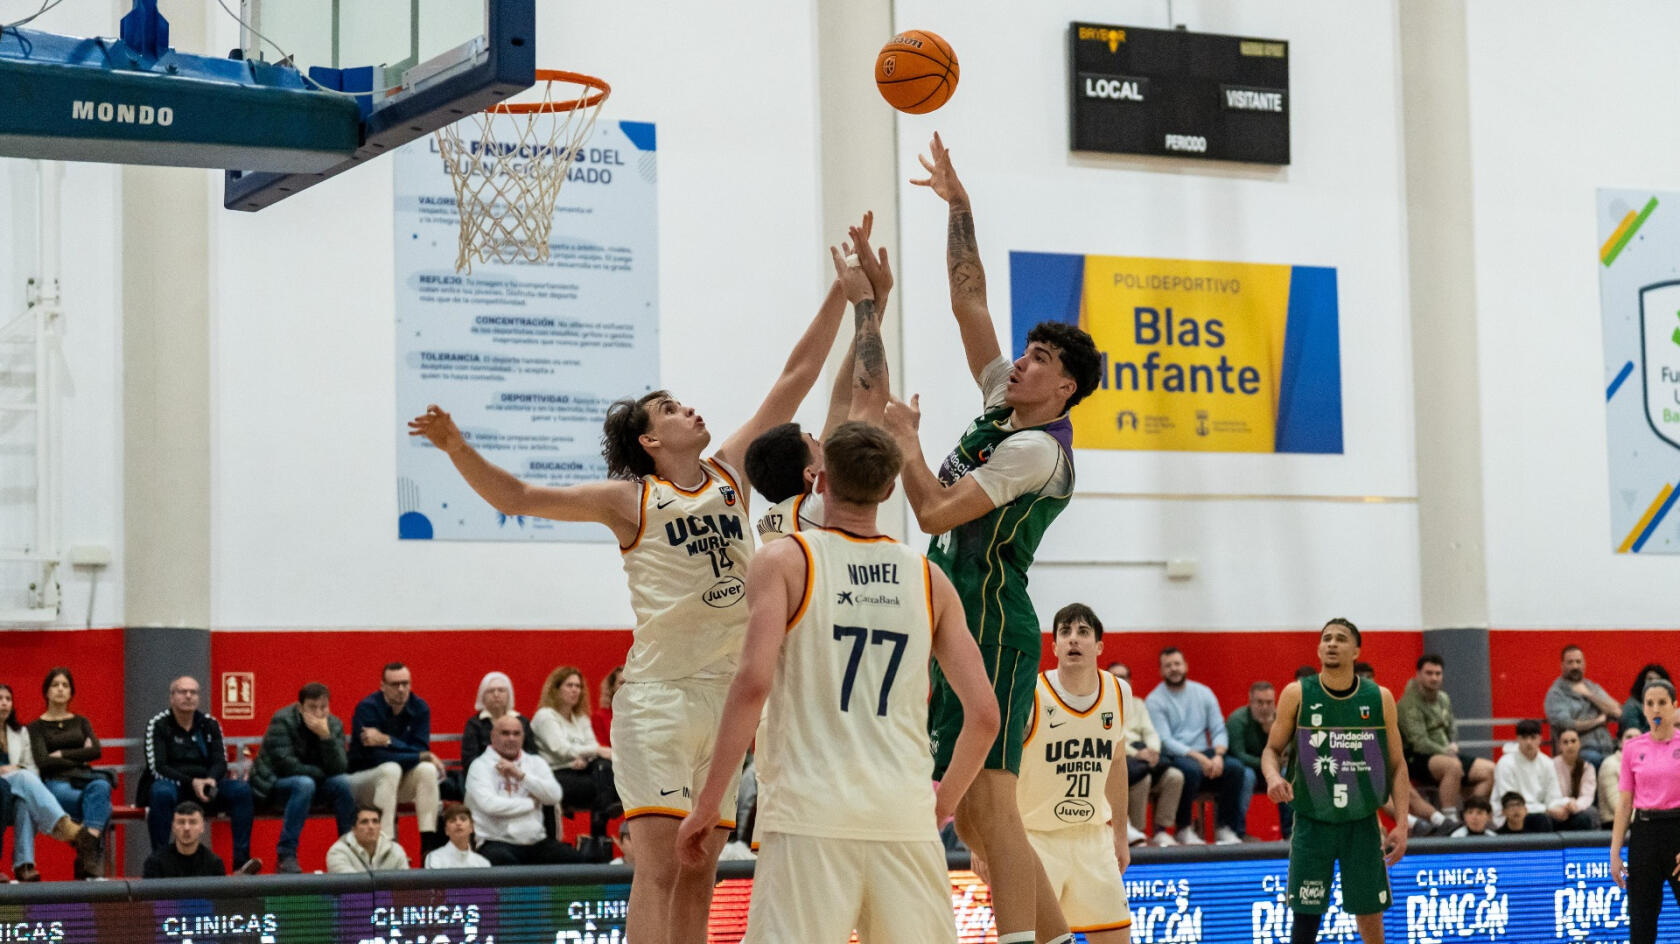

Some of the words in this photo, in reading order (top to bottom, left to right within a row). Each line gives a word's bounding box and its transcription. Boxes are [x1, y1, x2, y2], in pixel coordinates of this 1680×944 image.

[1086, 78, 1144, 101] LOCAL
[1226, 89, 1282, 112] VISITANTE
[72, 100, 174, 127] MONDO
[1165, 134, 1207, 152] PERIODO
[590, 148, 625, 166] DEL
[1113, 273, 1241, 295] POLIDEPORTIVO
[1133, 306, 1226, 348] Blas
[1100, 352, 1261, 395] Infante
[529, 460, 583, 470] EDUCACIÓN
[705, 547, 735, 578] 14
[847, 563, 900, 585] NOHEL
[707, 584, 742, 601] Juver
[855, 595, 900, 606] CaixaBank
[833, 624, 909, 717] 77
[1330, 732, 1375, 741] Fundación
[1330, 741, 1363, 751] Unicaja
[1045, 738, 1112, 763] UCAM
[1056, 761, 1103, 775] MURCIA
[1064, 773, 1091, 798] 20
[1333, 784, 1348, 808] 5
[1058, 806, 1091, 817] Juver
[1416, 867, 1498, 887] CLINICAS
[1126, 879, 1190, 898] INICAS
[163, 913, 279, 936] CLINICAS
[371, 904, 480, 926] CLINICAS
